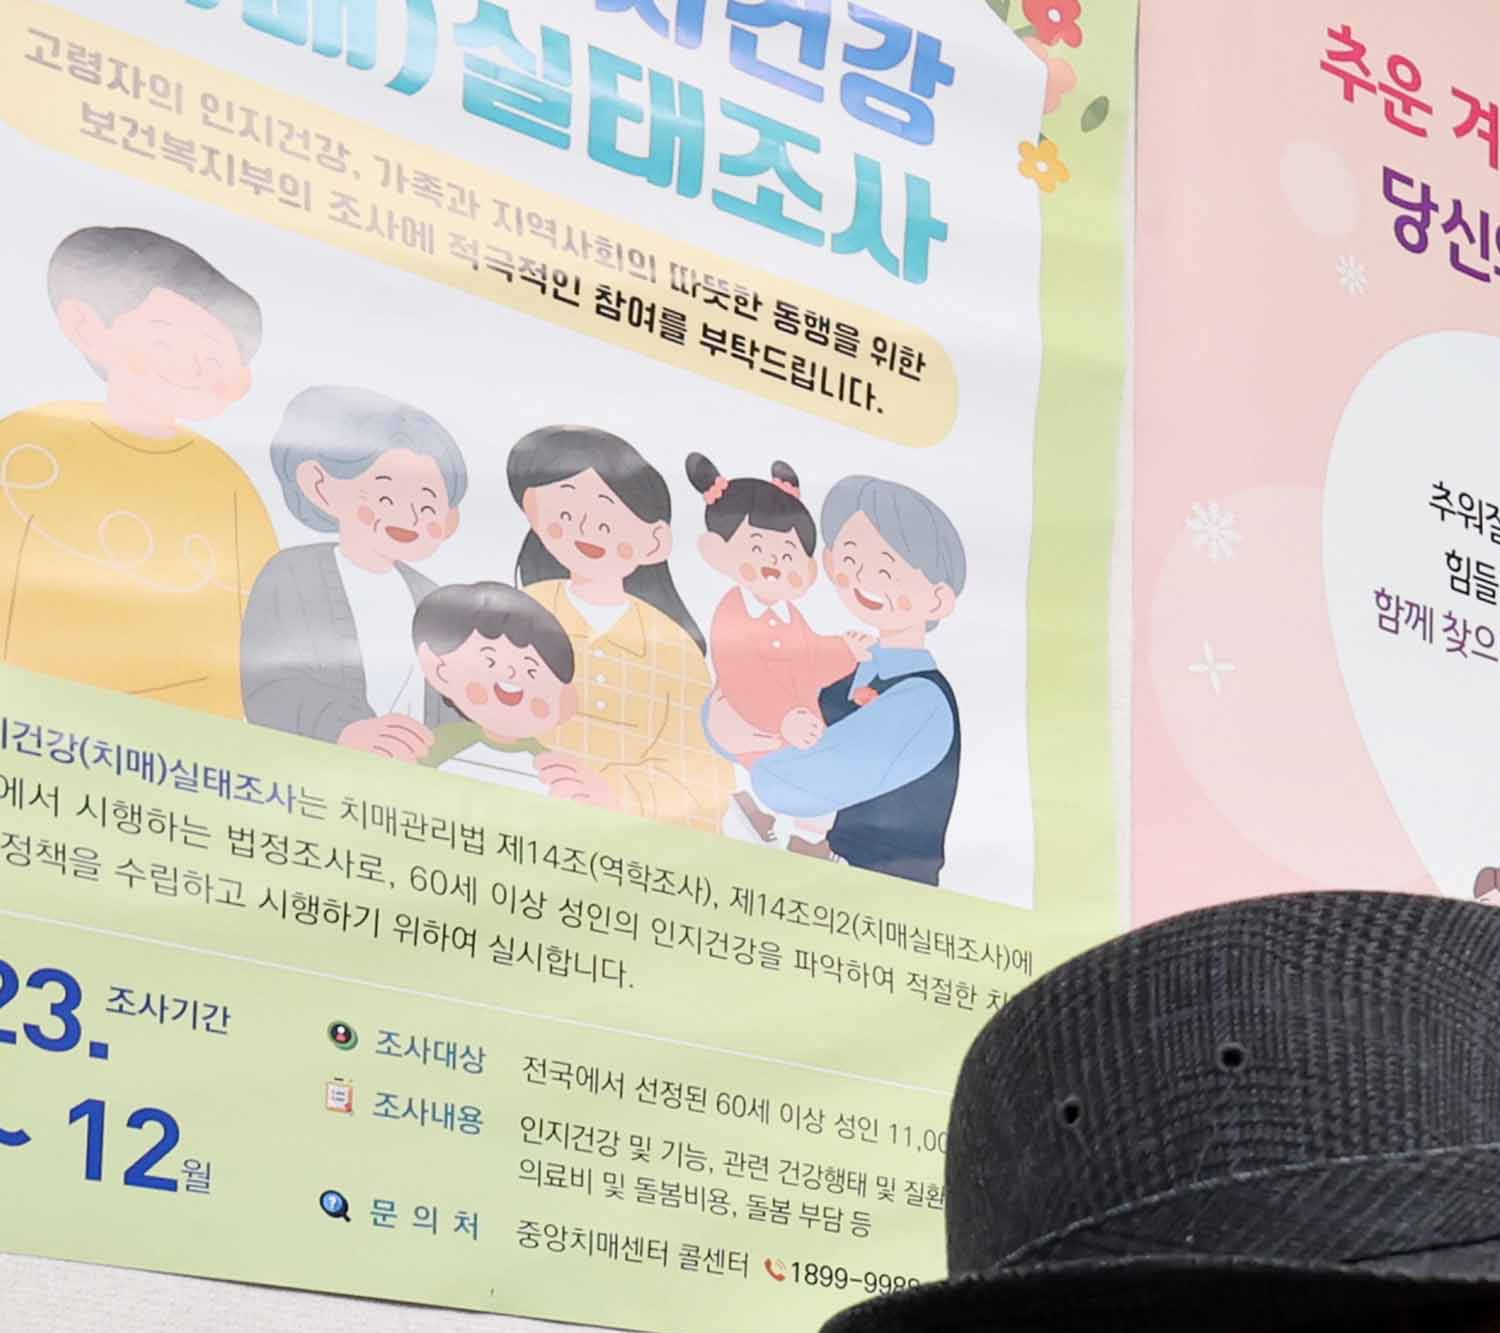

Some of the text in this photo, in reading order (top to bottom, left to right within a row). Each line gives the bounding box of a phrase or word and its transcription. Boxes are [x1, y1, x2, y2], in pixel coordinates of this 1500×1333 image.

[1320, 24, 1434, 138] 추운
[24, 28, 926, 382] 고령자의 인지건강, 가족과 지역사회의 따뜻한 동행을 위한
[80, 100, 884, 414] 보건복지부의 조사에 적극적인 참여를 부탁드립니다.
[1374, 586, 1435, 644] 함께
[0, 831, 633, 990] 정책을 수립하고 시행하기 위하여 실시합니다.
[77, 793, 211, 850] 시행하는
[227, 825, 396, 888] 법정조사로,
[409, 865, 478, 907] 60세
[491, 882, 547, 921] 이상
[559, 896, 639, 940] 성인의
[650, 917, 783, 971] 인지건강을
[794, 948, 895, 995] 파악하여
[906, 970, 978, 1012] 적절한
[339, 797, 485, 856] 치매관리법
[496, 829, 718, 909] 제14조(역학조사),
[729, 885, 1034, 977] 제14조의2(치매실태조사)에
[106, 985, 232, 1036] 조사기간
[374, 1028, 487, 1075] 조사대상
[523, 1055, 624, 1100] 전국에서
[635, 1073, 707, 1115] 선정된
[715, 1090, 770, 1126] 60세
[779, 1101, 826, 1135] 이상
[833, 1113, 879, 1144] 성인
[67, 1098, 212, 1195] 12월
[372, 1090, 485, 1136] 조사내용
[520, 1114, 621, 1158] 인지건강
[629, 1135, 652, 1163] 및
[661, 1140, 713, 1173] 기능,
[722, 1148, 770, 1184] 관련
[777, 1158, 867, 1198] 건강행태
[876, 1176, 897, 1203] 및
[517, 1158, 872, 1240] 의료비 및 돌봄비용, 돌봄 부담 등
[516, 1218, 669, 1269] 중앙치매센터
[678, 1242, 749, 1279] 콜센터
